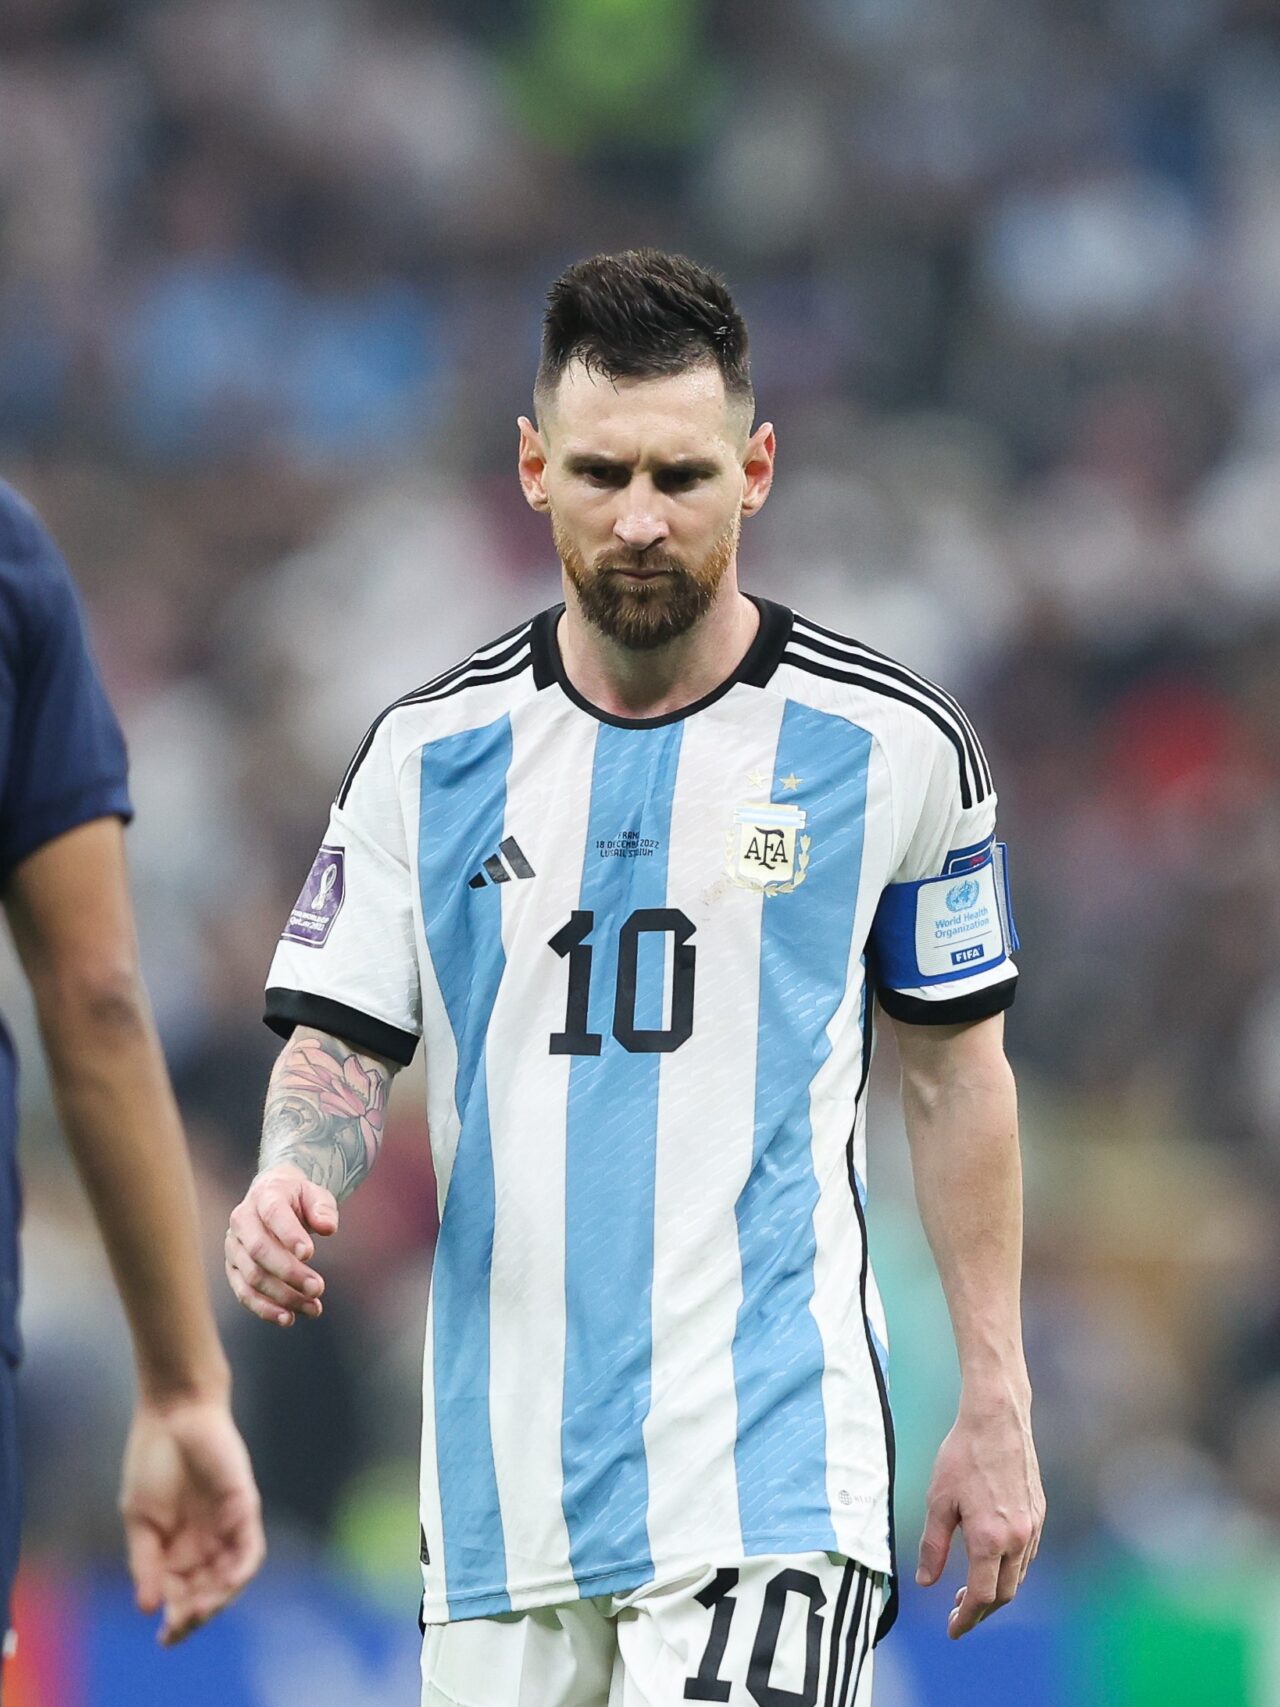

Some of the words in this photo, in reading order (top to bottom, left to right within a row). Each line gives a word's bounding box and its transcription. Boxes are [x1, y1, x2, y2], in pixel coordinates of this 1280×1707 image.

[596, 840, 605, 848] 18
[640, 839, 660, 849] 2022
[744, 826, 788, 870] AFA
[935, 915, 961, 929] World
[964, 906, 988, 921] Health
[935, 918, 990, 938] Organization
[955, 948, 980, 962] FIFA
[547, 908, 697, 1056] 10
[683, 1567, 827, 1707] 10
